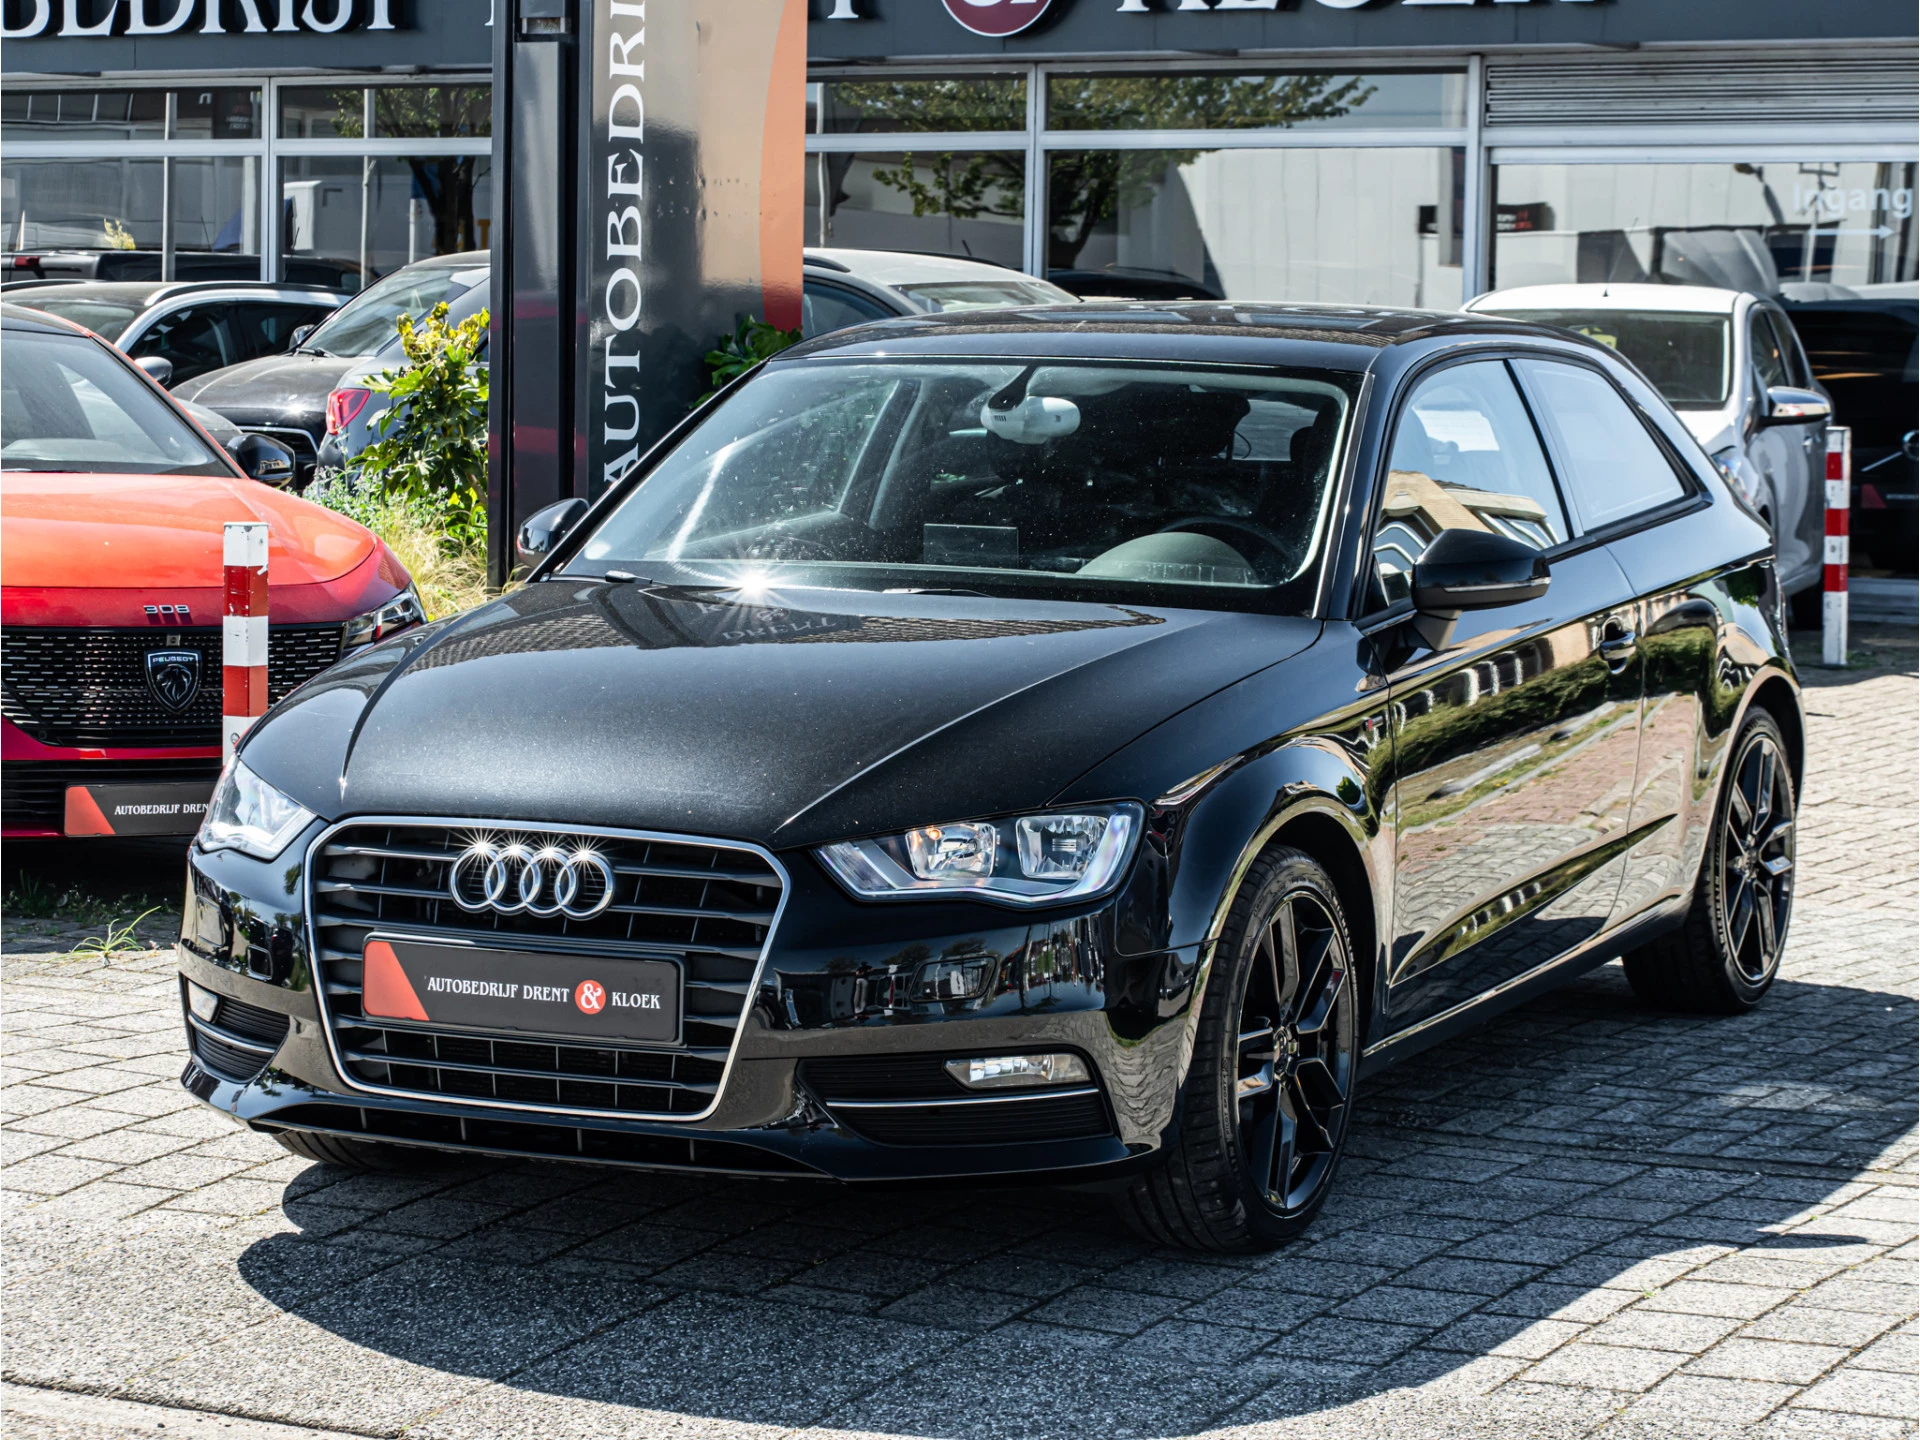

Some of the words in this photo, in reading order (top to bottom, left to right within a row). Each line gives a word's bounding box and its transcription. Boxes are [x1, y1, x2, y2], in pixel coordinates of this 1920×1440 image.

[1794, 183, 1912, 218] Ingang
[143, 605, 190, 614] 308
[114, 804, 180, 815] AUTOBEDRIJF
[427, 977, 519, 998] AUTOBEDRIJF
[522, 984, 570, 1003] DRENT
[580, 983, 602, 1009] &
[611, 991, 661, 1009] KLOEK
